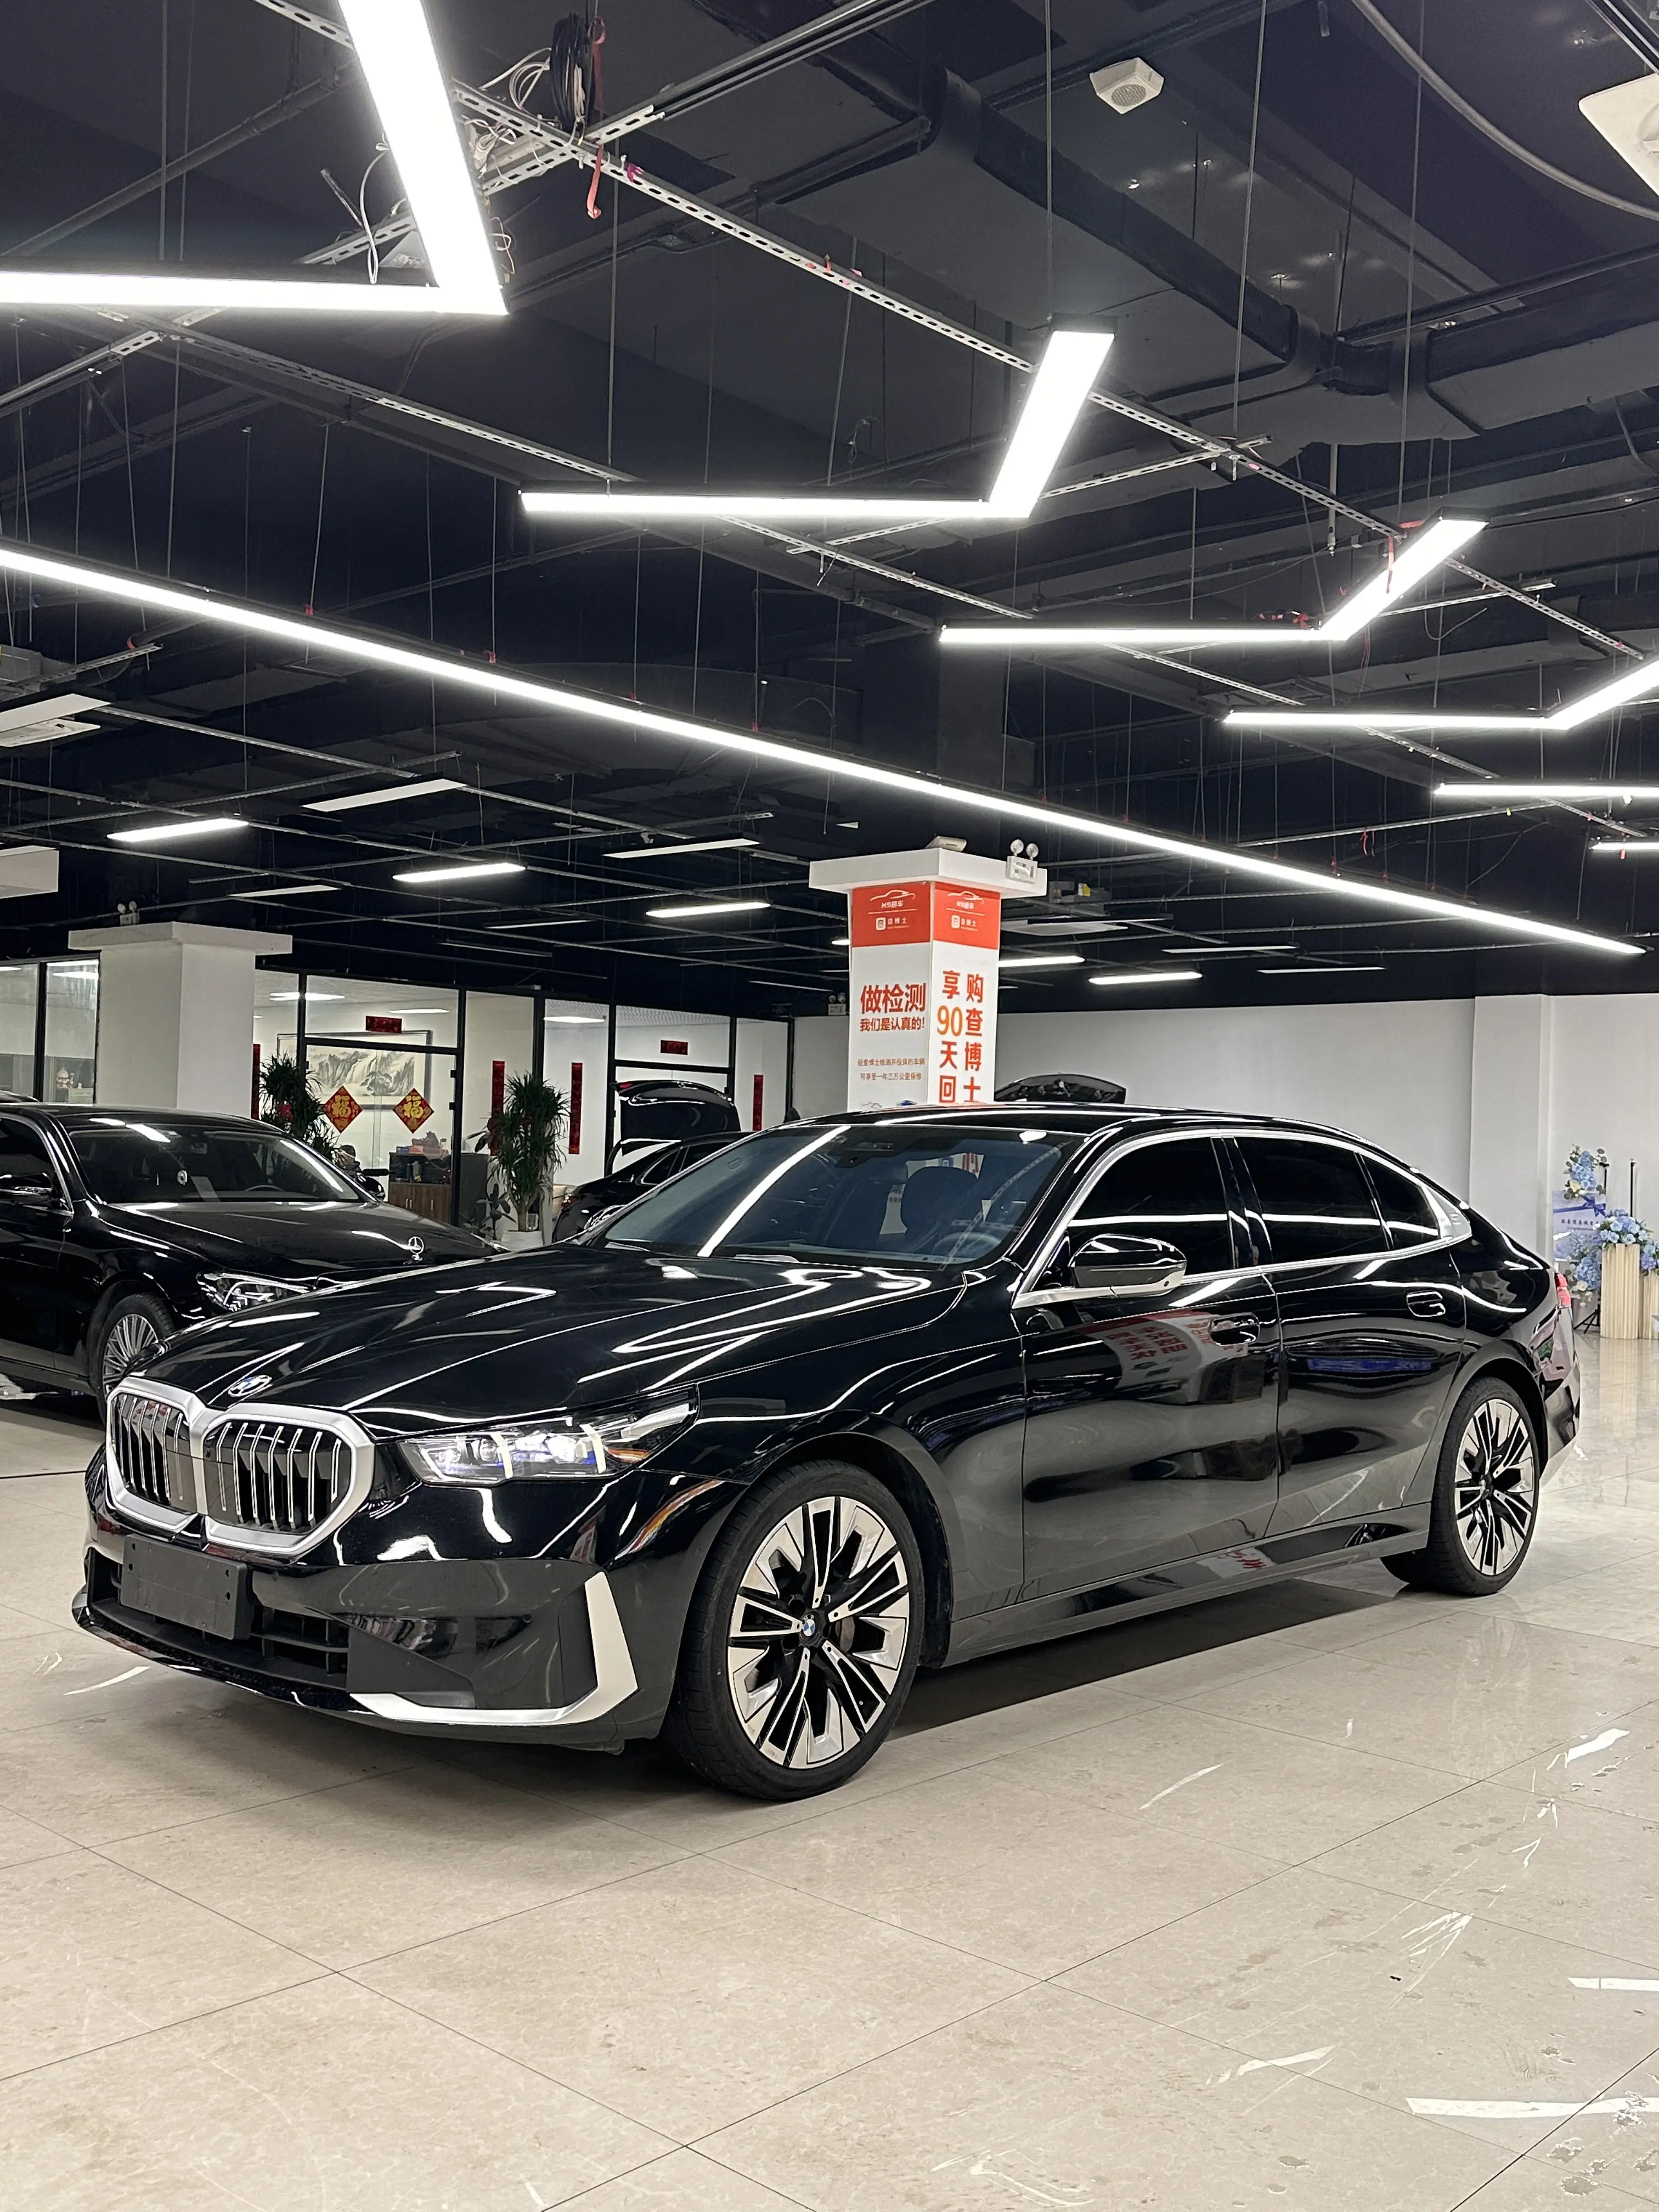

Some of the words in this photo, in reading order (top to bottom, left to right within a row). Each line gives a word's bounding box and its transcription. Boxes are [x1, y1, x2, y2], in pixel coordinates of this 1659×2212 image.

[860, 983, 926, 1014] 做检测
[860, 1017, 925, 1031] 我们是认真的！
[936, 970, 963, 1103] 享90天回
[963, 973, 984, 1103] 购查博士
[331, 1094, 352, 1118] 福
[403, 1095, 424, 1118] 福
